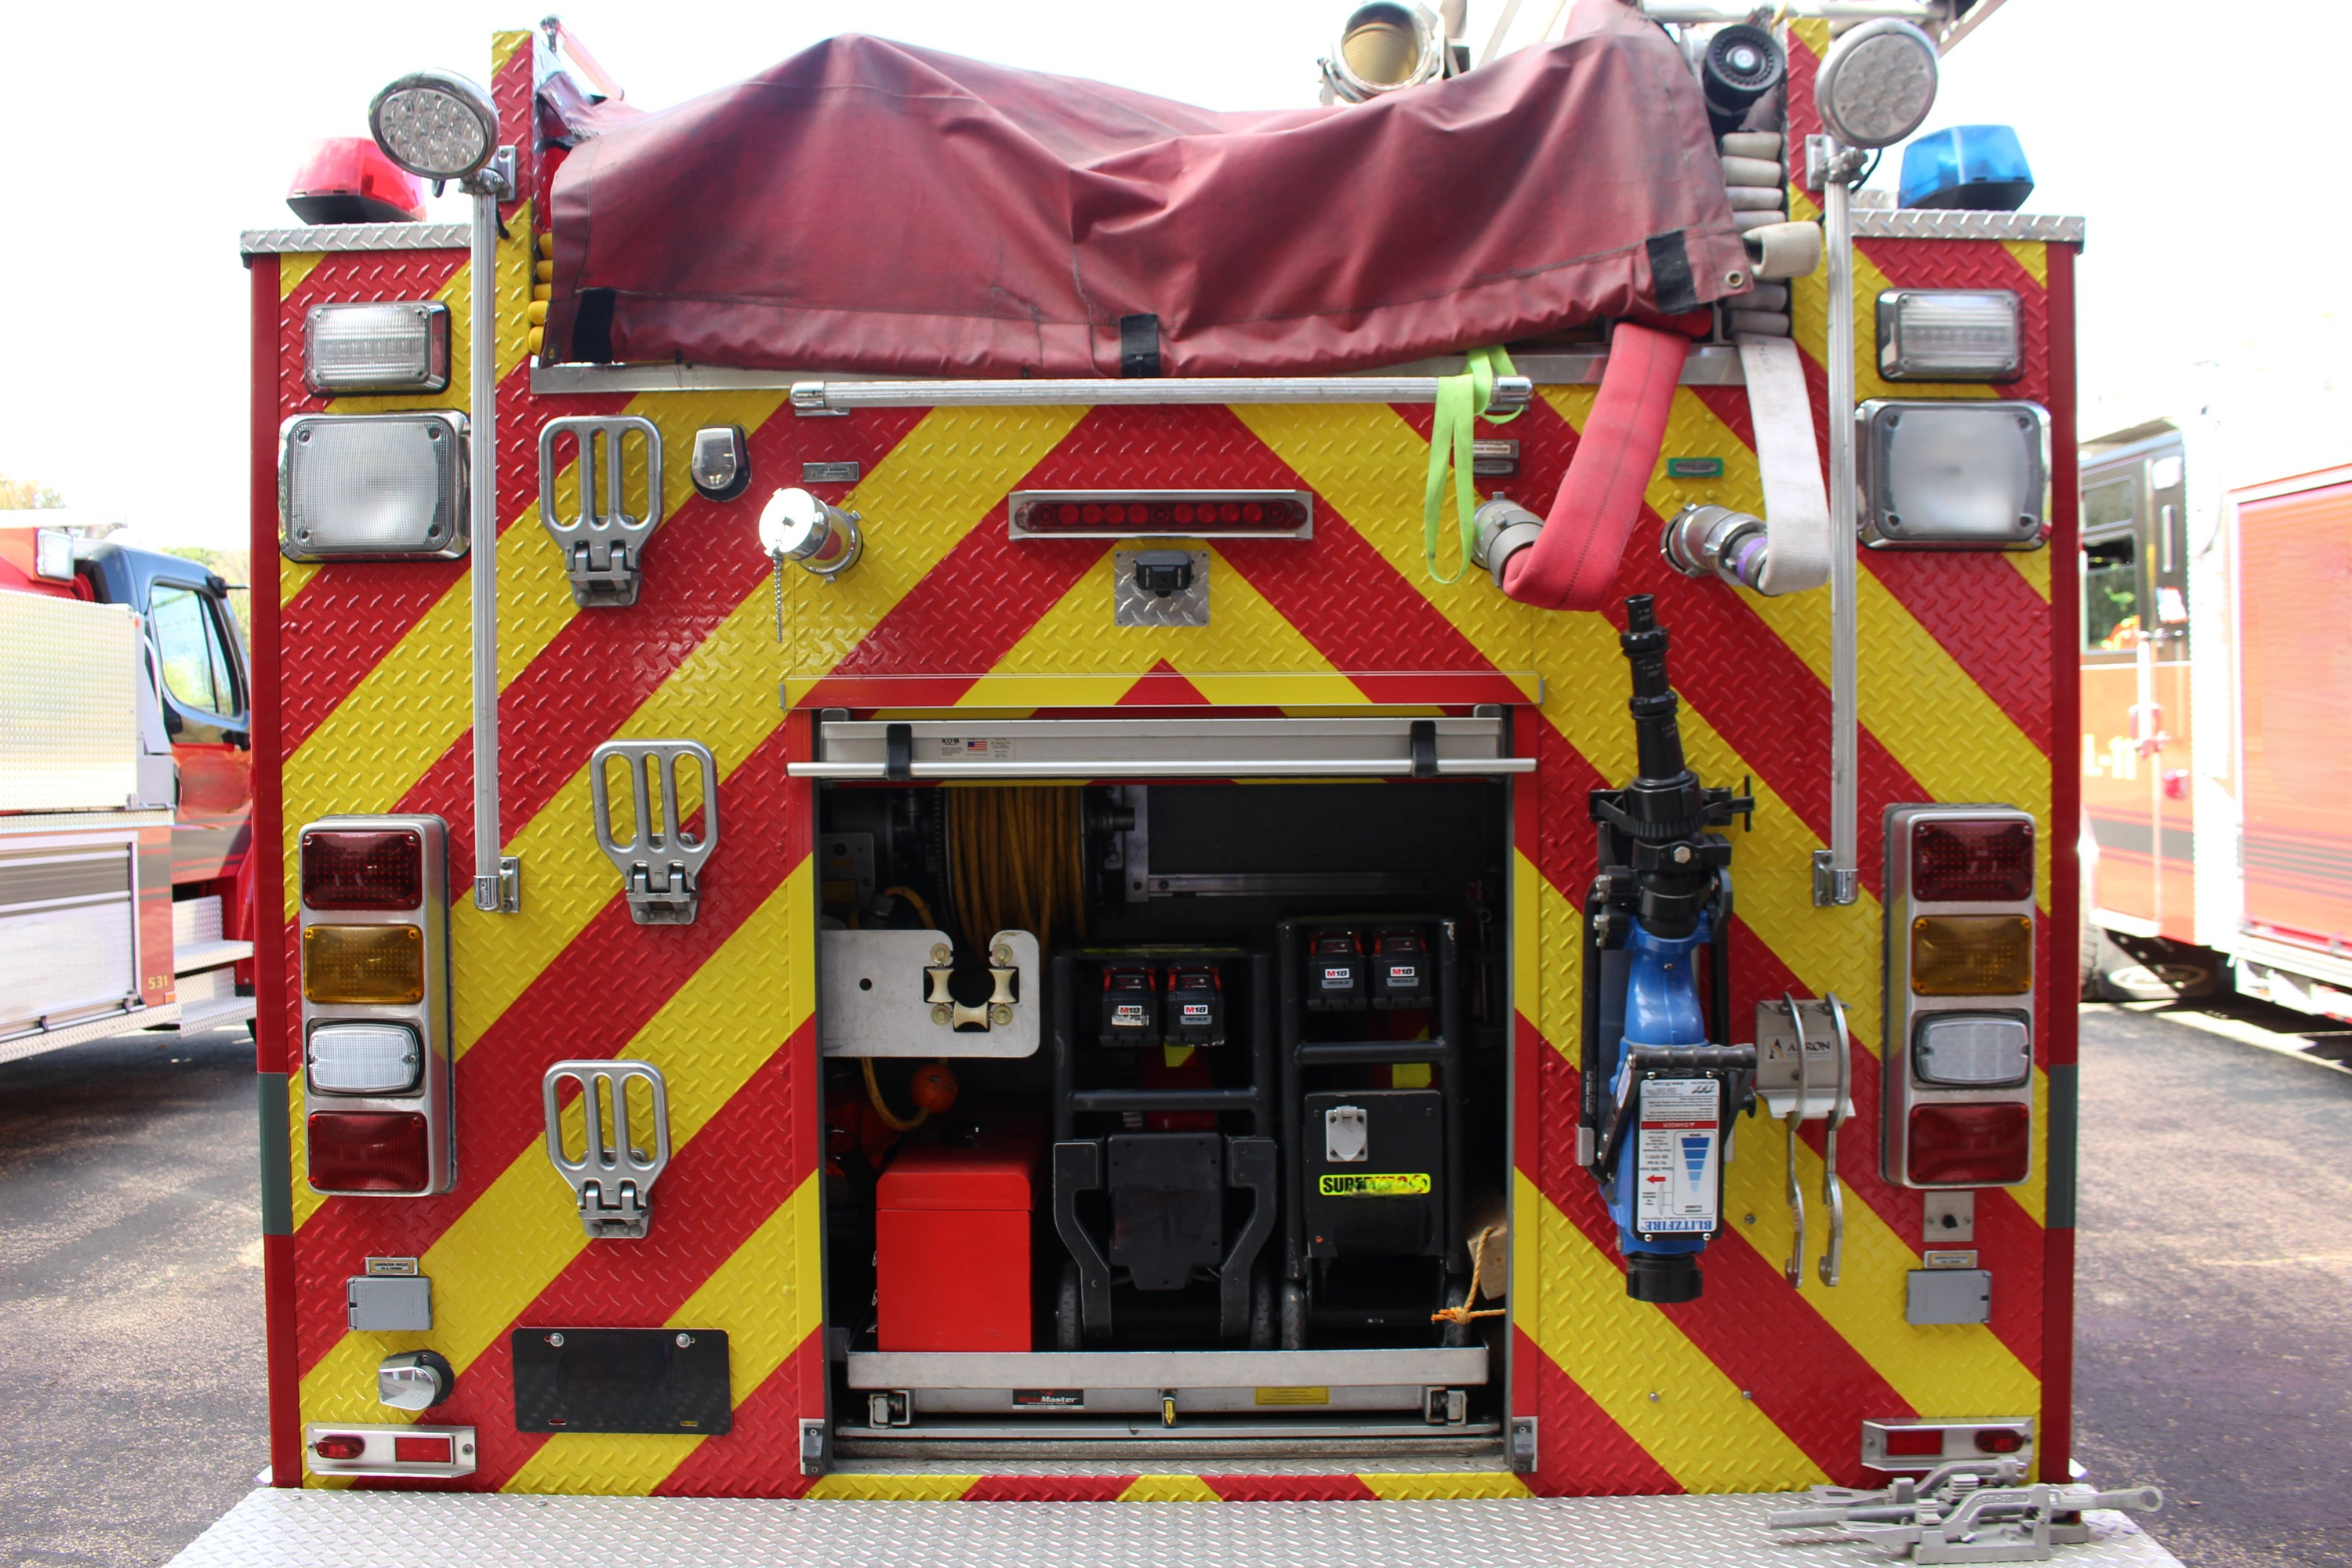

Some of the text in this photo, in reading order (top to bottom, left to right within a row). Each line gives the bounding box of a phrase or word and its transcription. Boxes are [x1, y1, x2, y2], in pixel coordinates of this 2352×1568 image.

[148, 975, 168, 990] 531
[1788, 1041, 1831, 1051] ARON
[1644, 1220, 1713, 1231] BLITZFIRE
